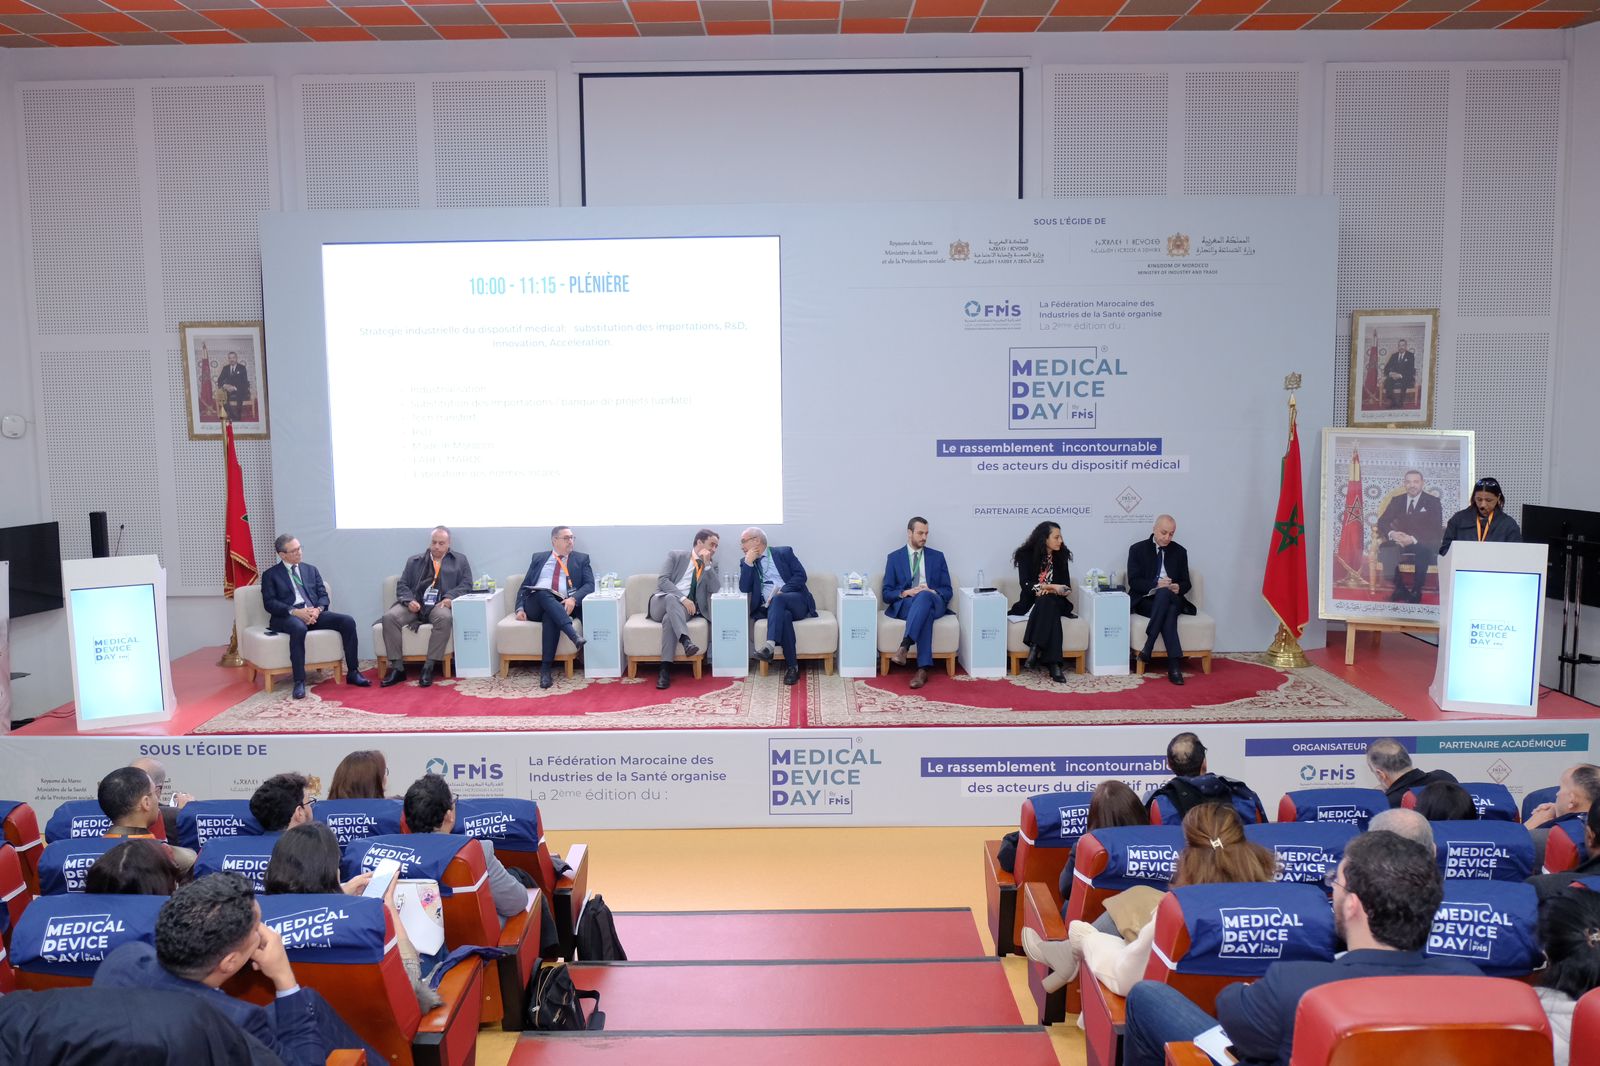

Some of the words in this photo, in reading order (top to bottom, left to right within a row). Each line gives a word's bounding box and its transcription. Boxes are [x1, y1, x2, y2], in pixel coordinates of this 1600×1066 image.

[1033, 218, 1057, 226] SOUS
[1095, 217, 1106, 225] DE
[469, 276, 506, 295] 10:00
[519, 276, 557, 295] 11:15
[569, 272, 630, 293] PLÉNIÈRE
[1051, 300, 1094, 308] Fédération
[1096, 299, 1138, 307] Marocaine
[1140, 299, 1155, 307] des
[1039, 311, 1080, 319] Industries
[1094, 310, 1101, 318] la
[1102, 310, 1126, 318] Santé
[1127, 310, 1162, 319] organise
[462, 325, 476, 335] du
[1039, 322, 1050, 331] La
[1108, 321, 1121, 330] du
[1012, 359, 1128, 377] MEDICAL
[1012, 381, 1105, 398] DEVICE
[1012, 403, 1064, 420] DAY
[942, 443, 957, 453] Le
[960, 442, 1054, 453] rassemblement
[1062, 441, 1157, 453] incontournable
[977, 460, 999, 471] des
[1002, 461, 1049, 471] acteurs
[1052, 460, 1068, 471] du
[1071, 459, 1128, 473] dispositif
[1132, 459, 1180, 470] médical
[974, 507, 1029, 515] PARTENAIRE
[1031, 505, 1091, 516] ACADÉMIQUE
[1471, 623, 1517, 632] MEDICAL
[1471, 631, 1508, 639] DEVICE
[94, 637, 139, 646] MEDICAL
[95, 645, 132, 654] DEVICE
[140, 744, 181, 756] SOUS
[186, 742, 243, 756] L'ÉGIDE
[247, 744, 268, 756] DE
[1292, 743, 1367, 752] ORGANISATEUR
[1439, 741, 1499, 749] PARTENAIRE
[1501, 738, 1567, 750] ACADÉMIQUE
[529, 756, 543, 766] La
[548, 755, 616, 766] Fédération
[620, 755, 688, 765] Marocaine
[691, 754, 714, 765] des
[772, 749, 882, 765] MEDICAL
[927, 762, 944, 773] Le
[947, 761, 1056, 773] rassemblement
[529, 771, 593, 782] Industries
[596, 771, 613, 782] de
[616, 771, 628, 781] la
[631, 770, 668, 782] Santé
[671, 770, 727, 783] organise
[772, 769, 861, 786] DEVICE
[967, 781, 993, 793] des
[996, 782, 1050, 793] acteurs
[1053, 781, 1071, 792] du
[530, 789, 546, 801] La
[585, 788, 637, 801] édition
[641, 788, 661, 800] du
[772, 790, 821, 806] DAY
[1319, 810, 1368, 818] MEDICAL
[198, 818, 246, 827] MEDICAL
[329, 816, 378, 826] MEDICAL
[465, 814, 516, 829] MEDICAL
[1062, 817, 1088, 827] DEVI
[72, 828, 109, 838] DEVIC
[198, 827, 238, 836] DEVICE
[466, 823, 507, 837] DEVICE
[1062, 826, 1085, 835] DAY
[337, 834, 353, 843] AY
[368, 847, 422, 865] MEDICAL
[1129, 849, 1180, 860] MEDICA
[1275, 851, 1337, 863] MEDICAL
[1449, 847, 1510, 858] MEDICAL
[224, 860, 268, 870] MEDIC
[1129, 860, 1178, 872] DEVICE
[1448, 858, 1497, 868] DEVICE
[1273, 872, 1303, 882] DAY
[1447, 868, 1476, 878] DAY
[68, 880, 87, 888] DA
[267, 909, 349, 934] MEDICAL
[1224, 914, 1303, 929] MEDICAL
[1434, 908, 1513, 926] MEDICAL
[47, 920, 126, 937] MEDICAL
[282, 922, 334, 945] EVICE
[1432, 922, 1498, 939] DEVICE
[1224, 929, 1289, 943] DEVICE
[43, 935, 109, 952] DEVICE
[1223, 942, 1260, 953] DAY
[1429, 935, 1469, 950] DAY
